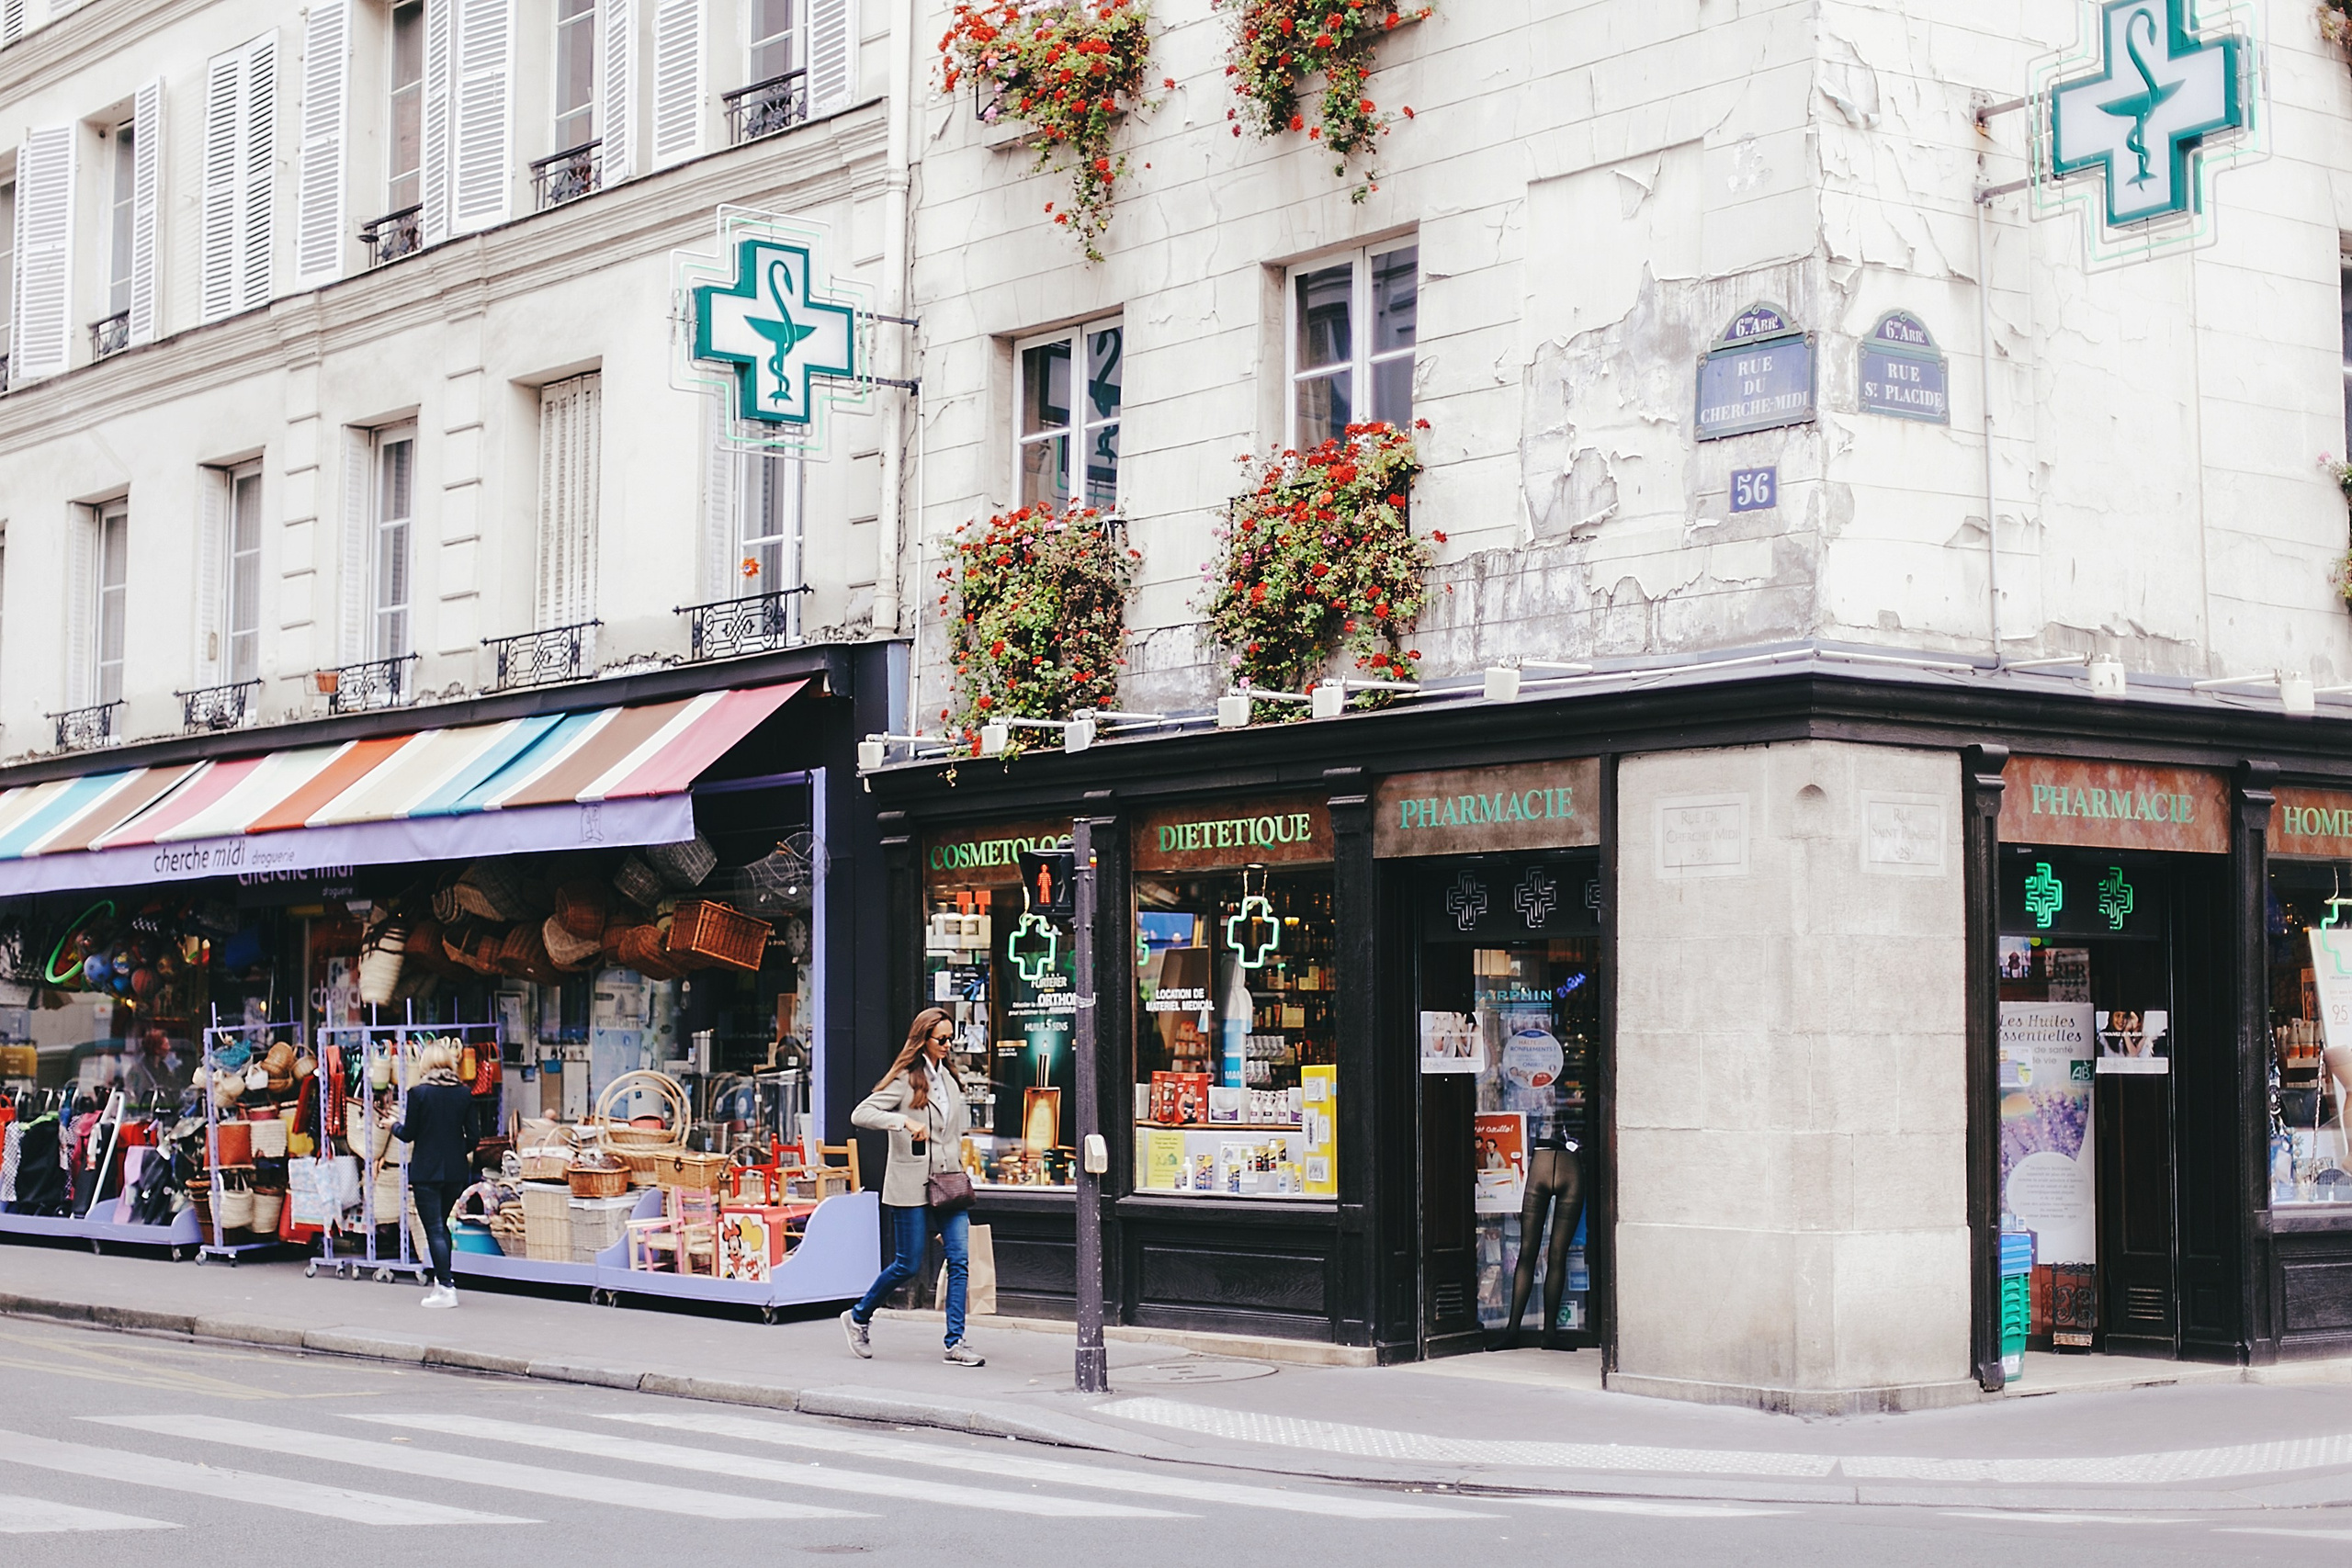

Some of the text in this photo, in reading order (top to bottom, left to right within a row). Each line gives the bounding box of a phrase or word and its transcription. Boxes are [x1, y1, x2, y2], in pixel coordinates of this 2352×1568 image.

[1737, 356, 1773, 377] RUE
[1887, 363, 1920, 382] RUE
[1744, 378, 1766, 396] DU
[1885, 385, 1943, 408] PLACIDE
[1701, 391, 1809, 423] CHERCHE-MIDI
[1737, 472, 1769, 505] 56
[1399, 787, 1575, 829] PHARMACIE
[2031, 784, 2195, 824] PHARMACIE
[1680, 810, 1721, 825] RUE DU
[1893, 808, 1912, 823] RUE
[1159, 813, 1312, 852] DIETETIQUE
[1714, 828, 1738, 840] MIDI
[154, 840, 295, 873] cherche midi droguerie
[930, 833, 1074, 871] COSMETOLO
[1155, 987, 1205, 1000] LOCATION DE
[1474, 989, 1553, 1002] DARPHIN
[1145, 998, 1216, 1011] MATERIEL MEDICAL
[2332, 1004, 2348, 1021] 95
[1024, 1021, 1045, 1032] HUILE
[1999, 1013, 2075, 1028] Les Huiles
[1999, 1029, 2082, 1043] ssentielles
[2034, 1045, 2074, 1055] de santé
[2072, 1066, 2090, 1080] AB
